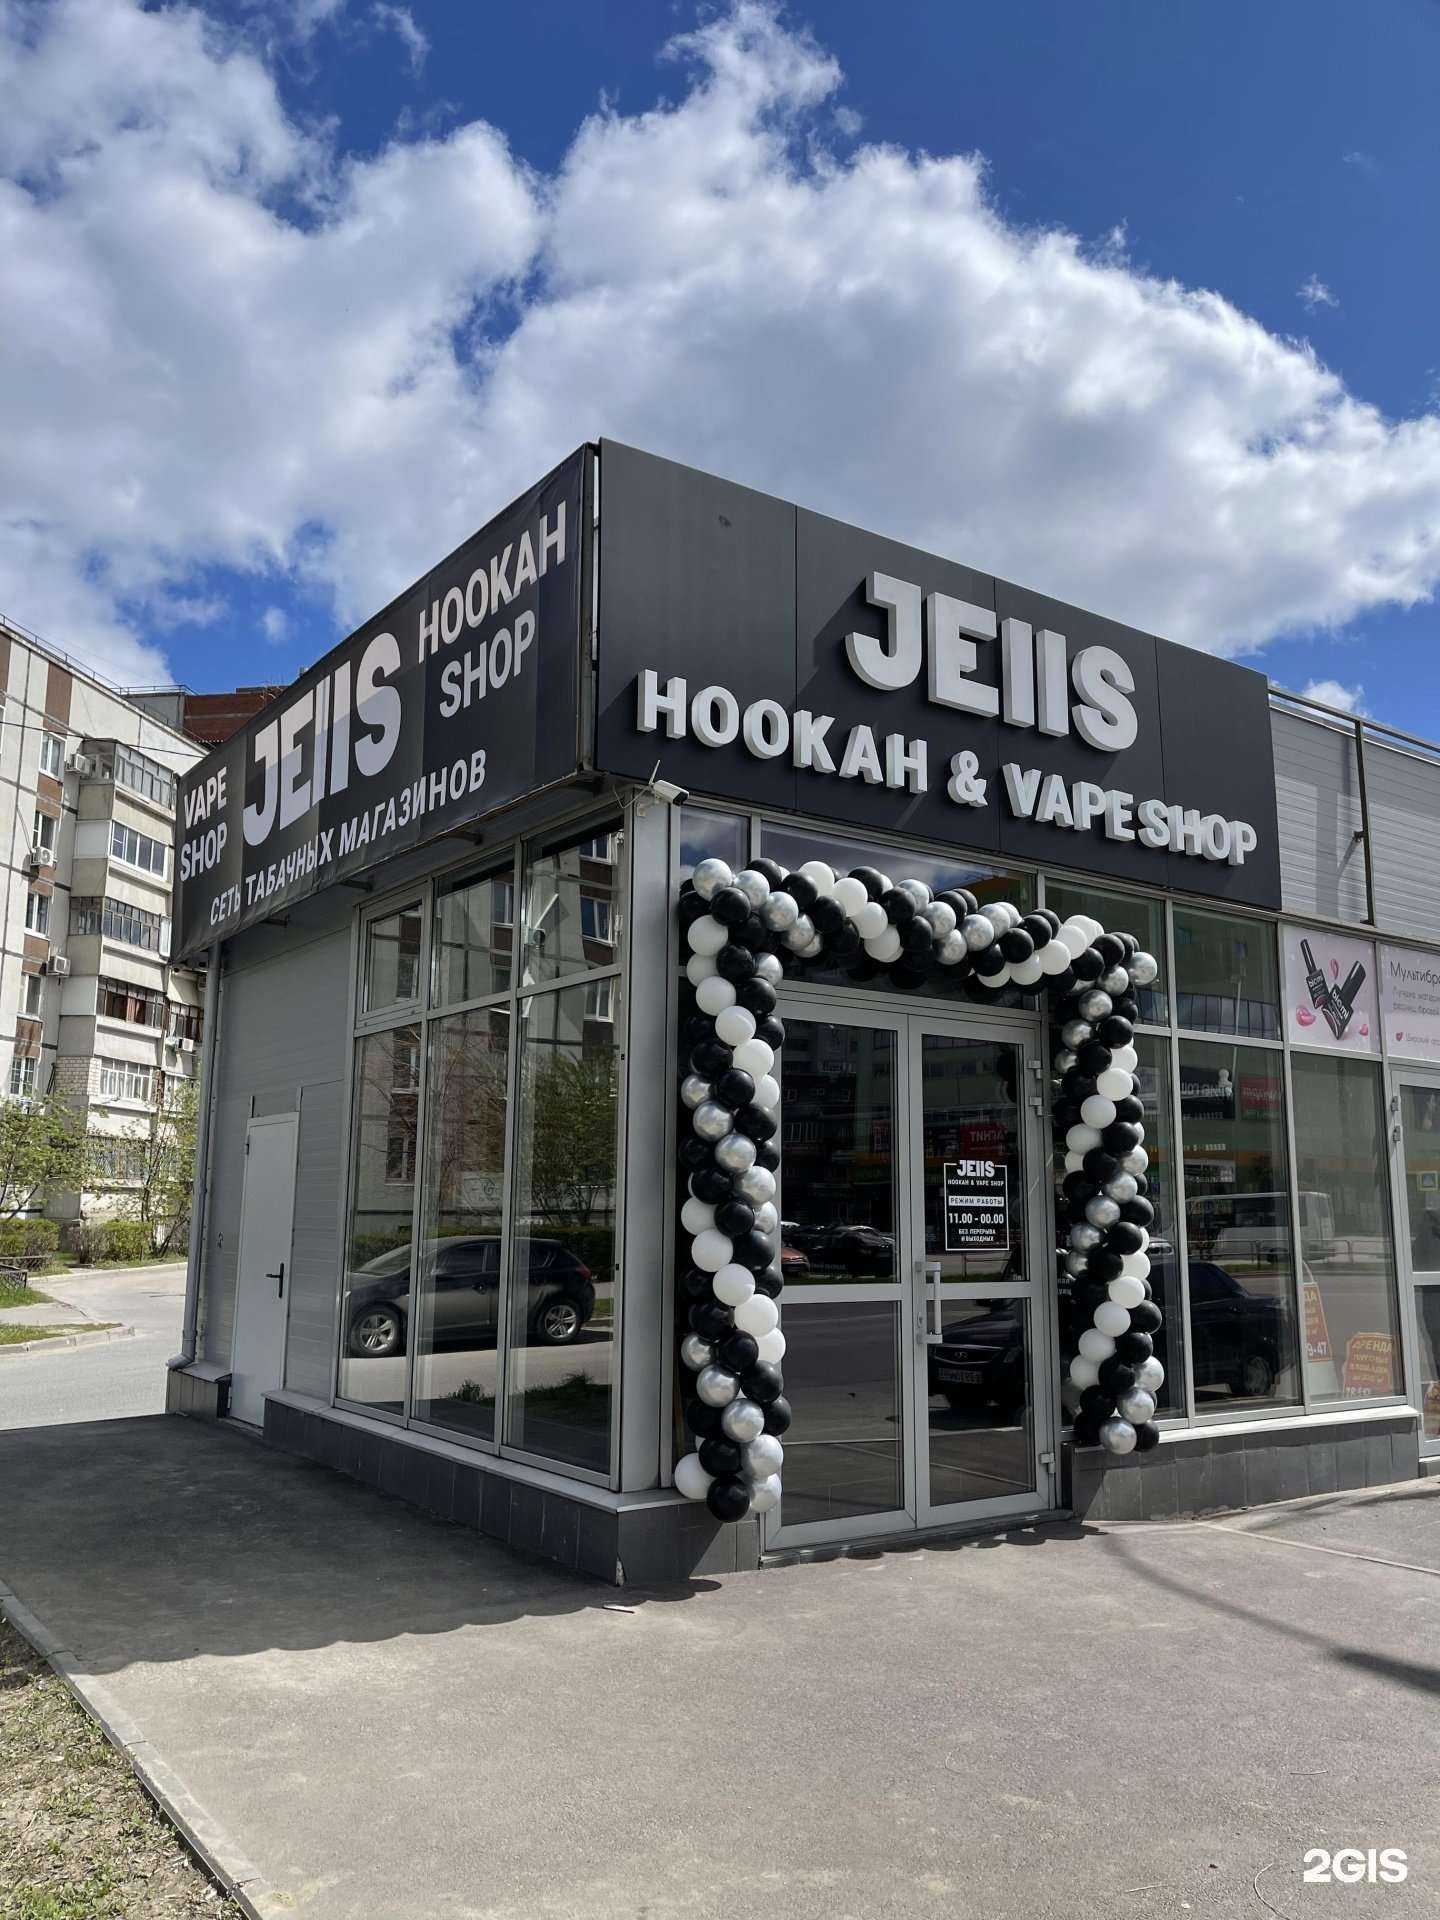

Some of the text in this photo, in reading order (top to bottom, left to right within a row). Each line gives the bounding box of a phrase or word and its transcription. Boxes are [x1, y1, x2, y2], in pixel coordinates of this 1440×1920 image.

[419, 501, 567, 664] HOOKAH
[439, 609, 535, 718] SHOP
[184, 766, 228, 830] VAPE
[636, 669, 1257, 866] HOOKAH & VAPE SHOP
[180, 821, 228, 883] SHOP
[209, 748, 487, 927] СЕТЬ ТАБАЧНЫХ МАГАЗИНОВ
[948, 1212, 973, 1224] 11.00
[980, 1213, 1004, 1224] 00.00
[950, 1197, 1003, 1206] РЕЖИМ РАБОТЫ
[965, 1235, 994, 1243] ВЫХОДНЫХ
